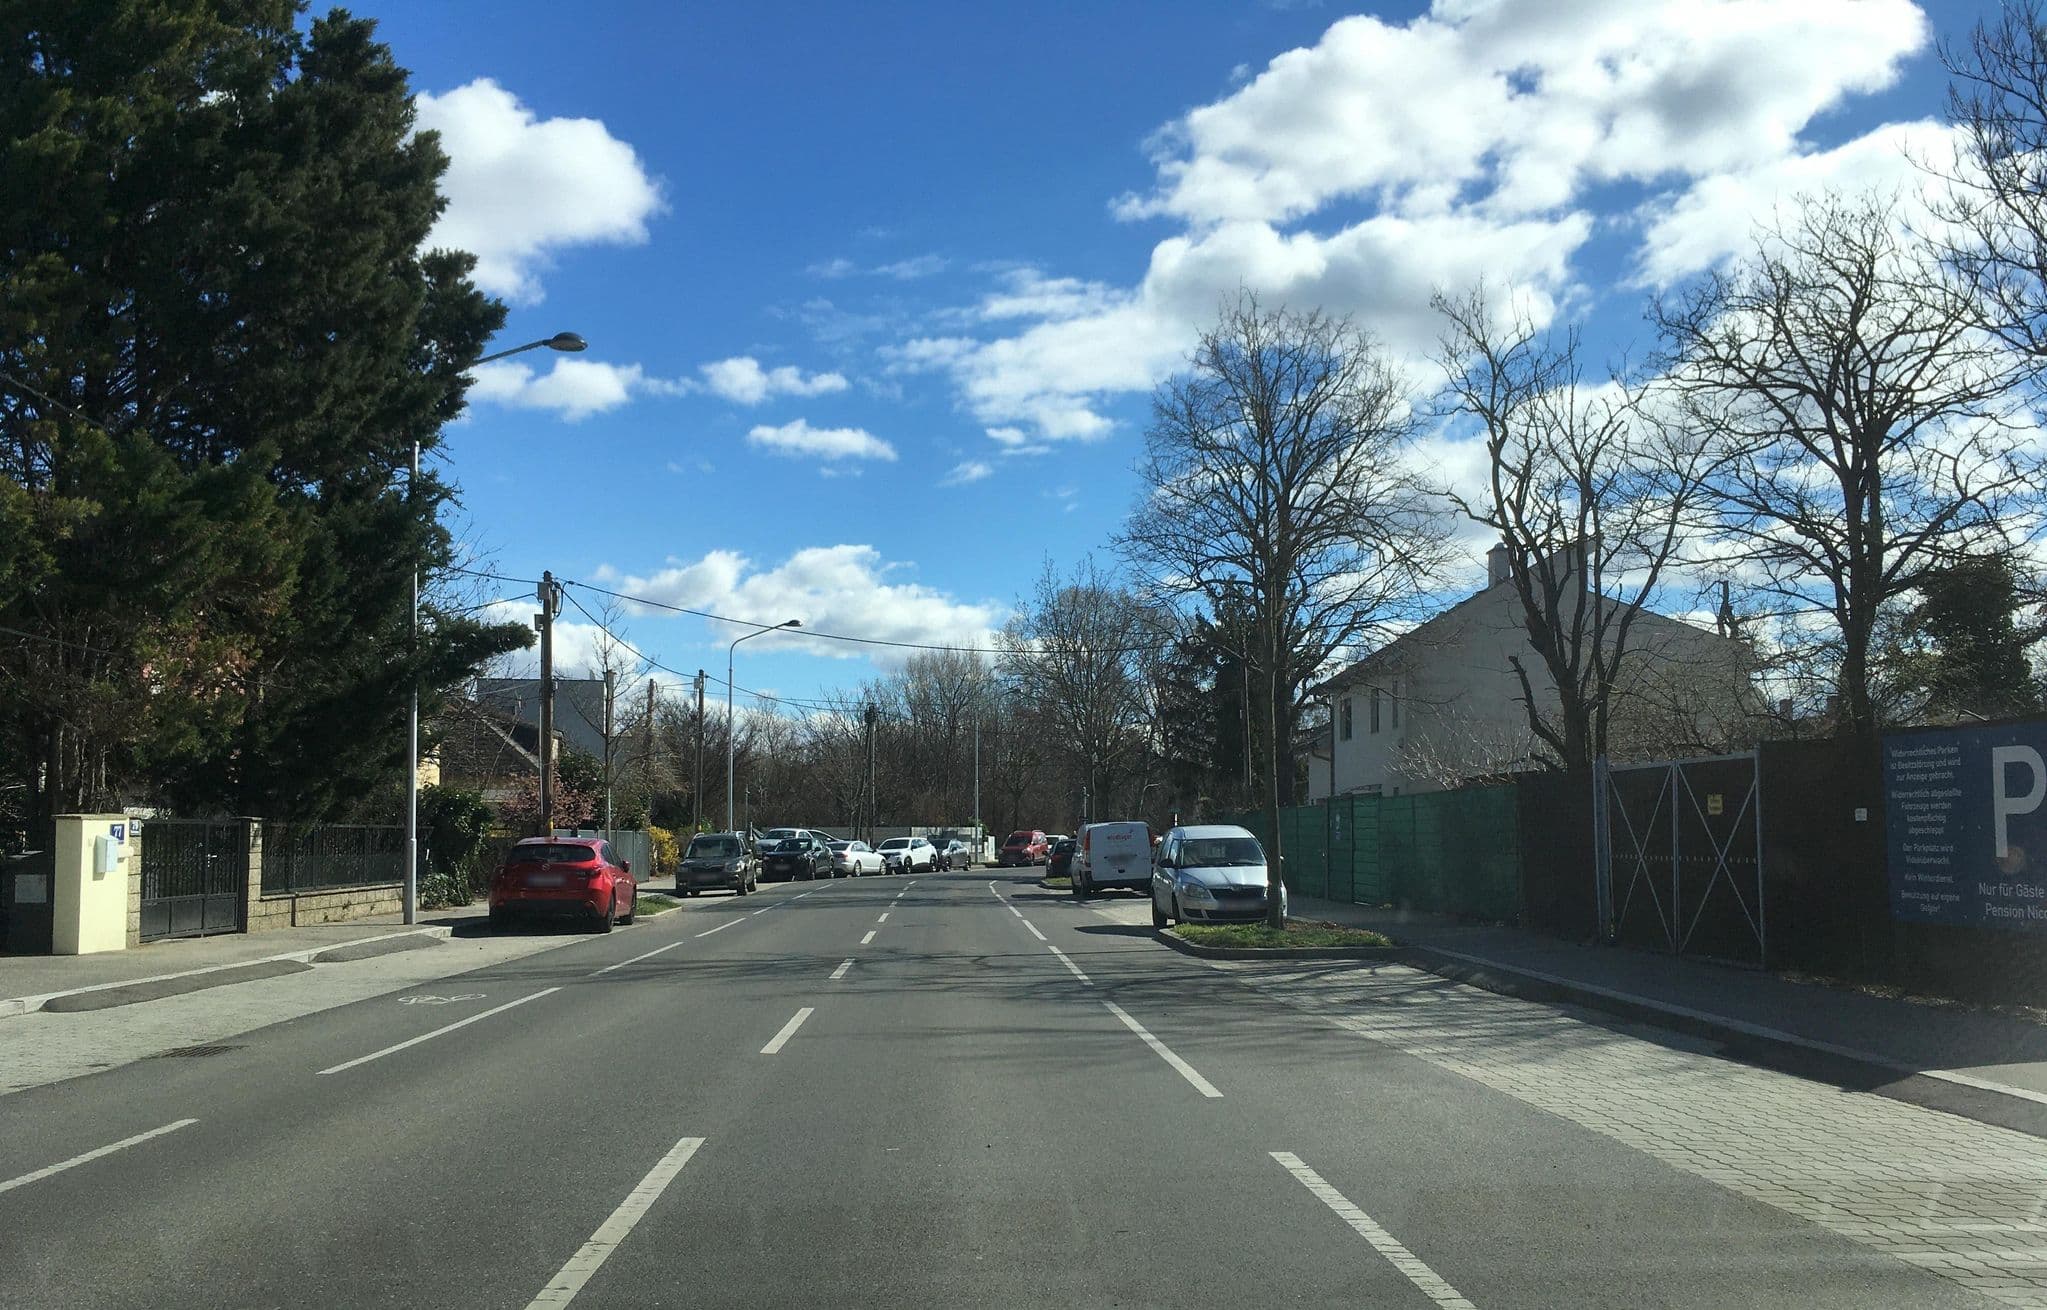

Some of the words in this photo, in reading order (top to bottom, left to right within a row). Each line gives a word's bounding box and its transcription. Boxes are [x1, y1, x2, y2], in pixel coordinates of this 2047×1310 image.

[1993, 745, 2047, 858] P
[1978, 882, 1997, 895] Nur
[1999, 882, 2014, 896] für
[2016, 883, 2045, 898] Gäste
[1985, 902, 2025, 918] Pension
